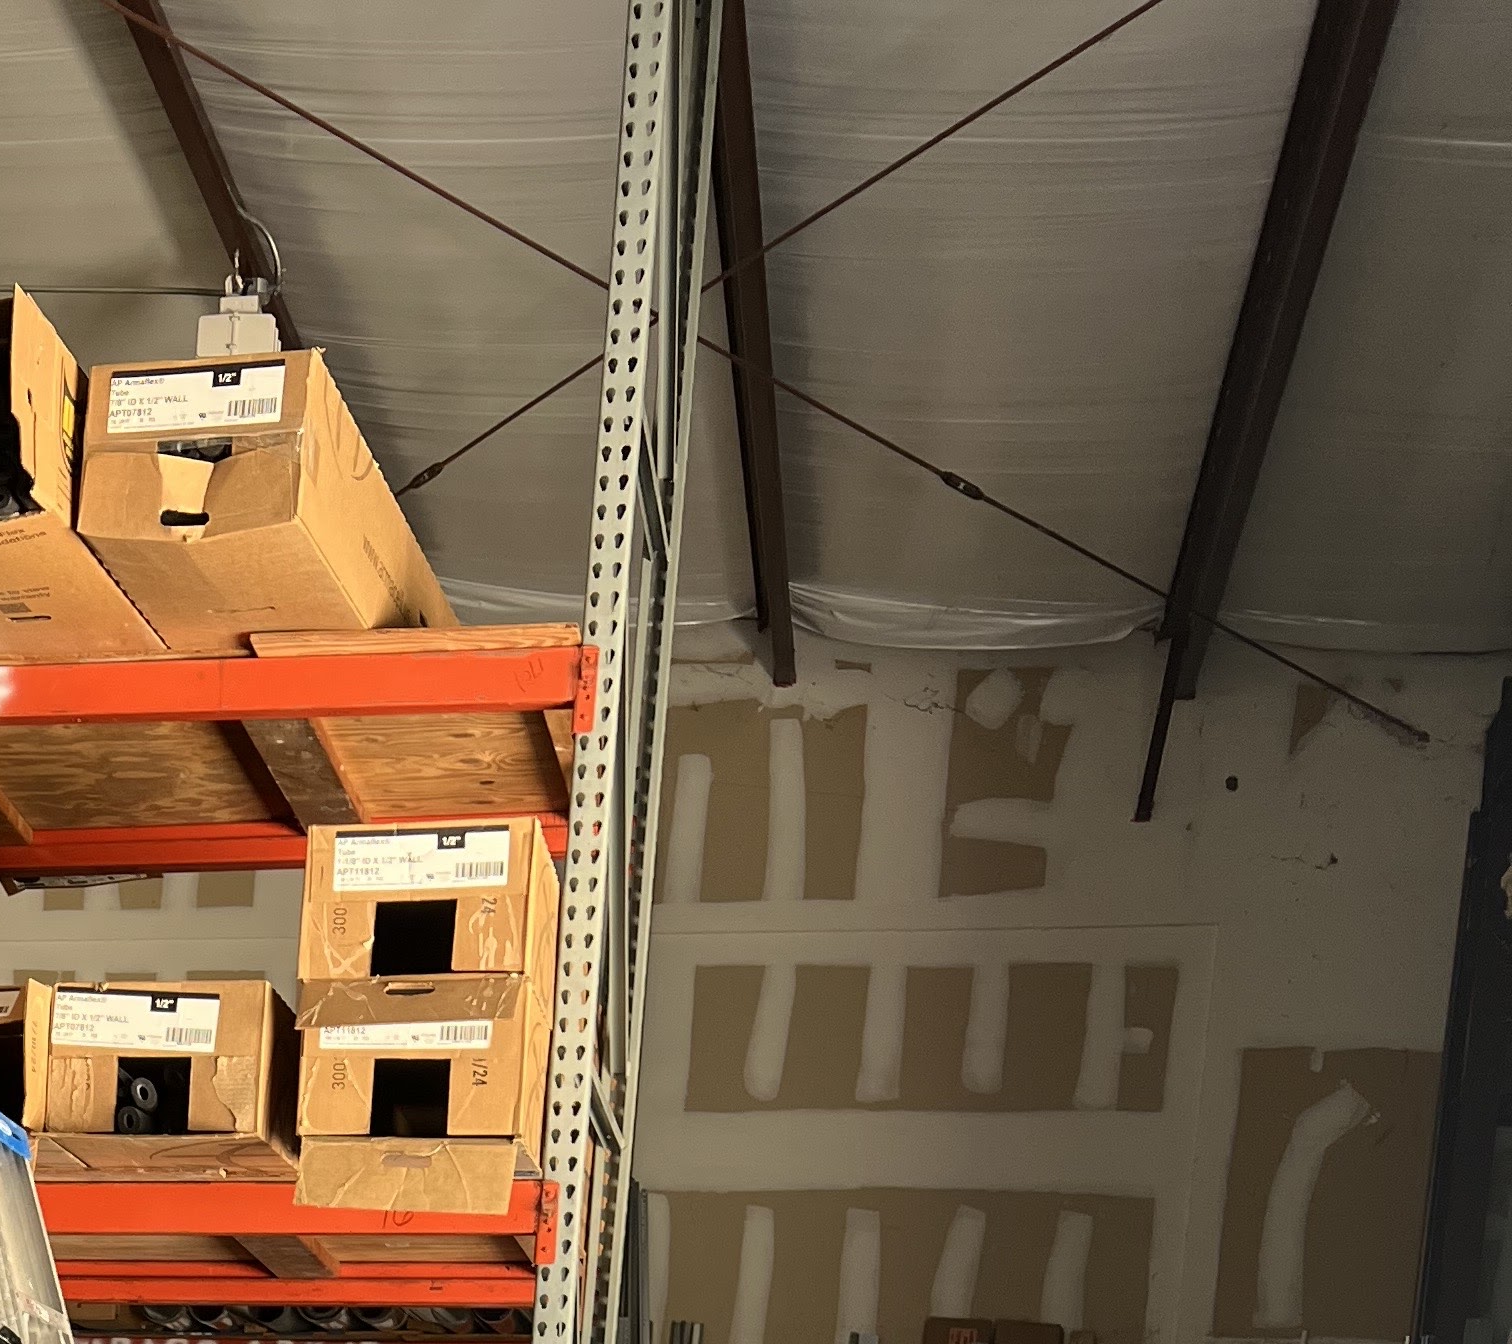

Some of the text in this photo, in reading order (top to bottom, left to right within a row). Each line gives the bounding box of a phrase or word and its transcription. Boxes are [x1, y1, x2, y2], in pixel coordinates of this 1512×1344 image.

[217, 372, 237, 383] 1/2"
[164, 395, 189, 404] WALL
[441, 836, 462, 846] 1/2"
[154, 998, 175, 1009] 1/2"
